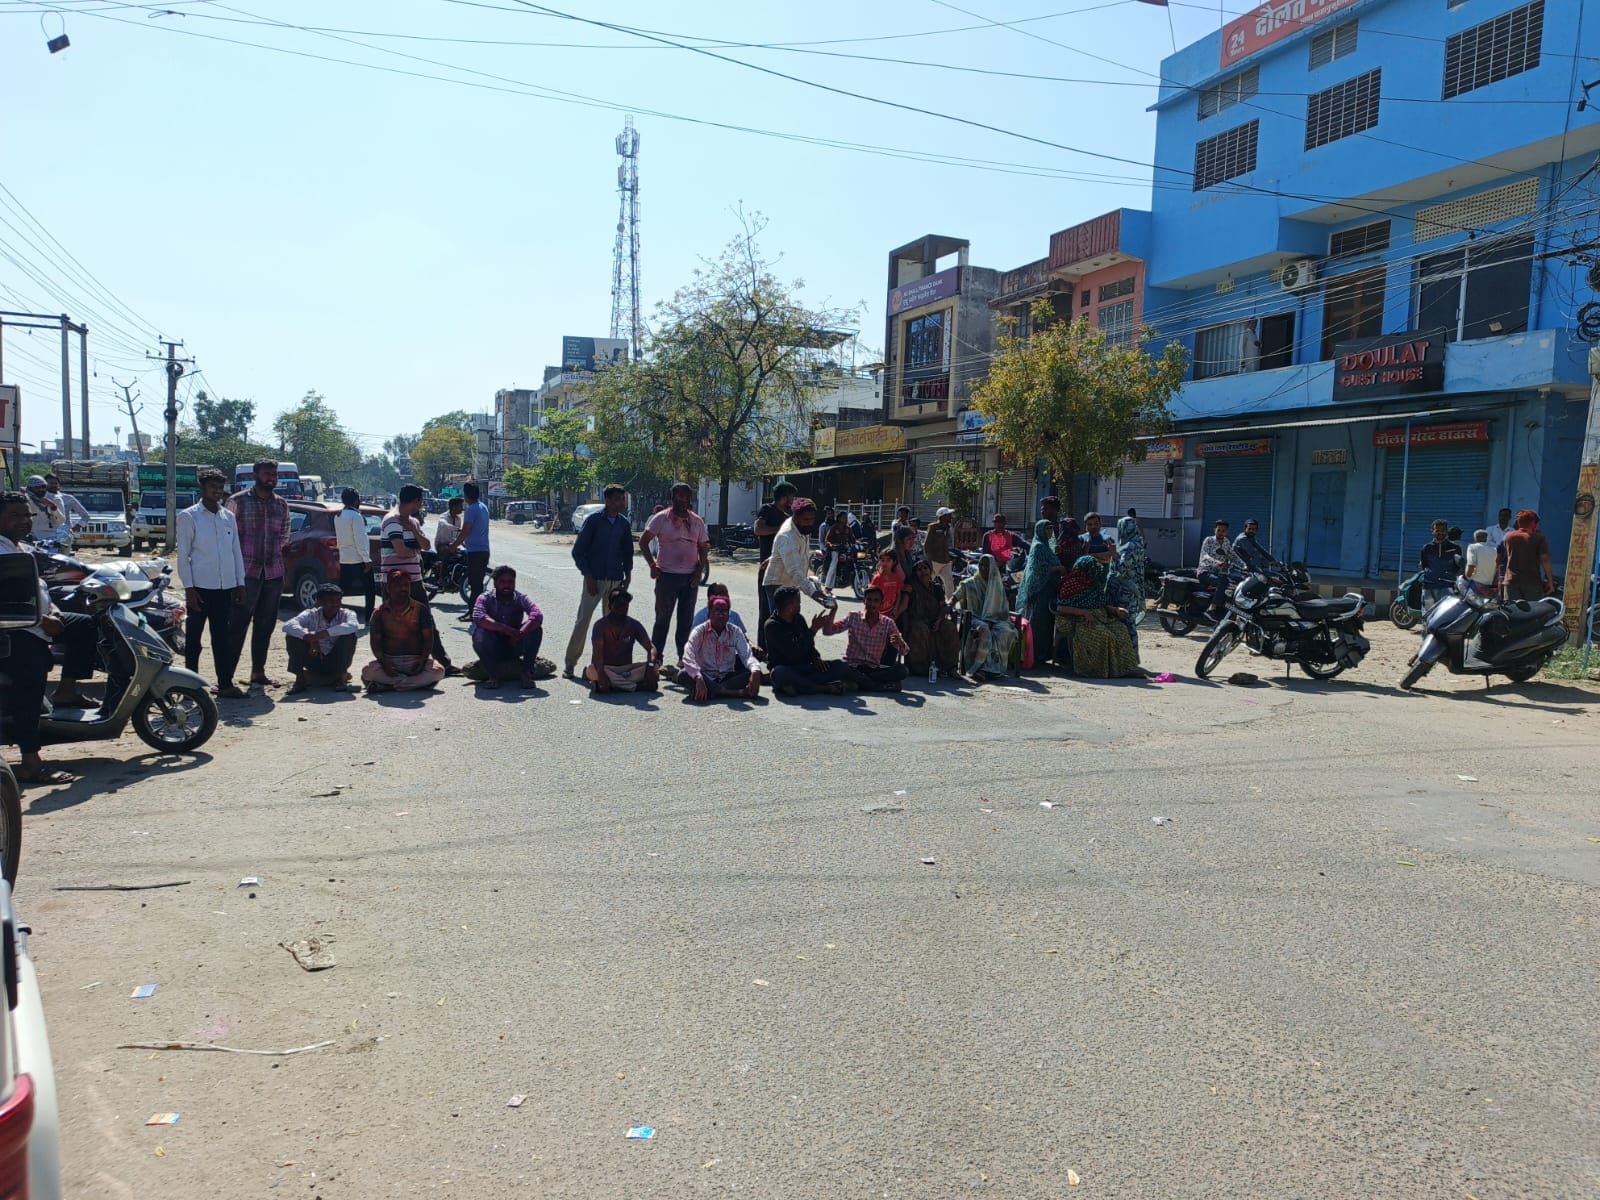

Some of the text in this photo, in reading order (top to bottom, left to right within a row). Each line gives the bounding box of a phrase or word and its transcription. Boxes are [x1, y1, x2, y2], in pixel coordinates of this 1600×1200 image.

[1231, 30, 1245, 49] 24
[1341, 341, 1429, 371] DOULAT
[1341, 367, 1423, 387] GUEST HOUSE
